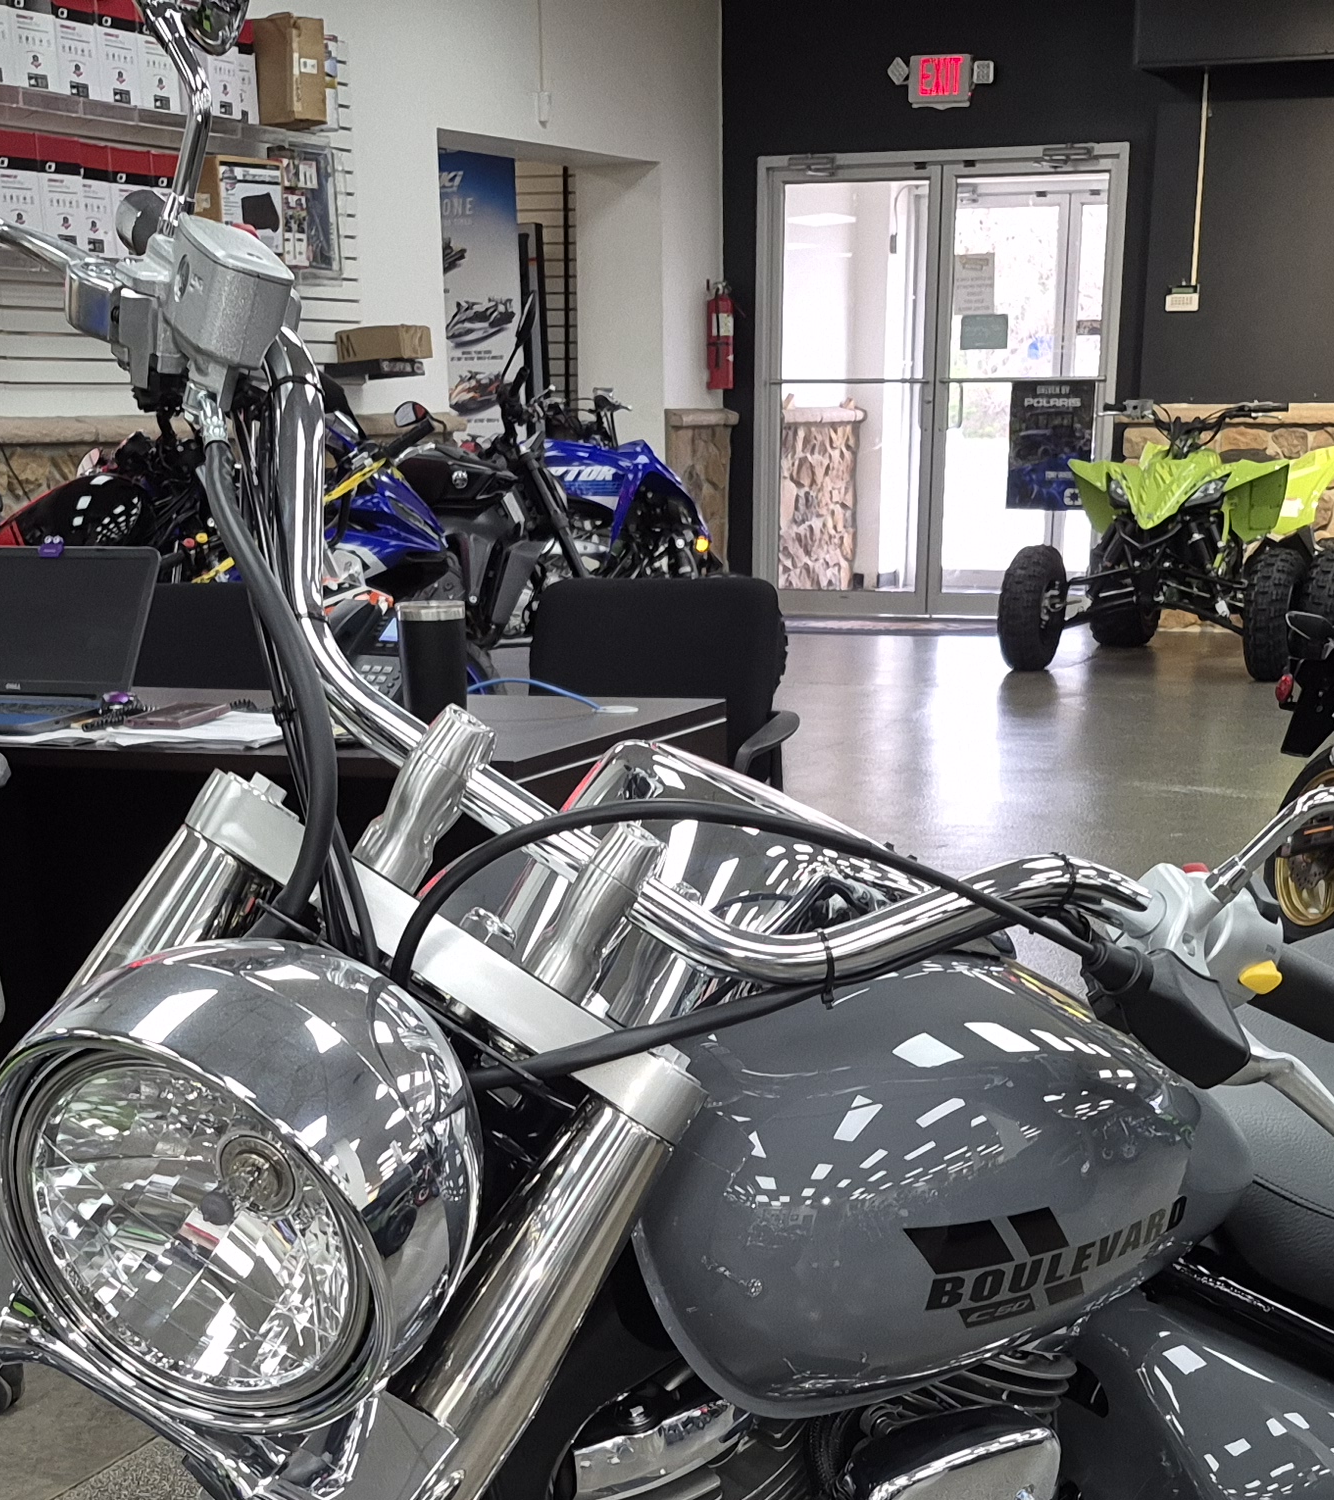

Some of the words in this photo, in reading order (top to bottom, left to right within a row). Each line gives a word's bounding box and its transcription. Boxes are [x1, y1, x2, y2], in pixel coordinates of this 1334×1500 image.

[918, 56, 964, 96] EXIT
[339, 334, 357, 361] M
[1024, 397, 1082, 408] POLARIS
[548, 465, 617, 481] PTOR
[925, 1195, 1187, 1311] BOULEVARD
[966, 1300, 1029, 1323] C50
